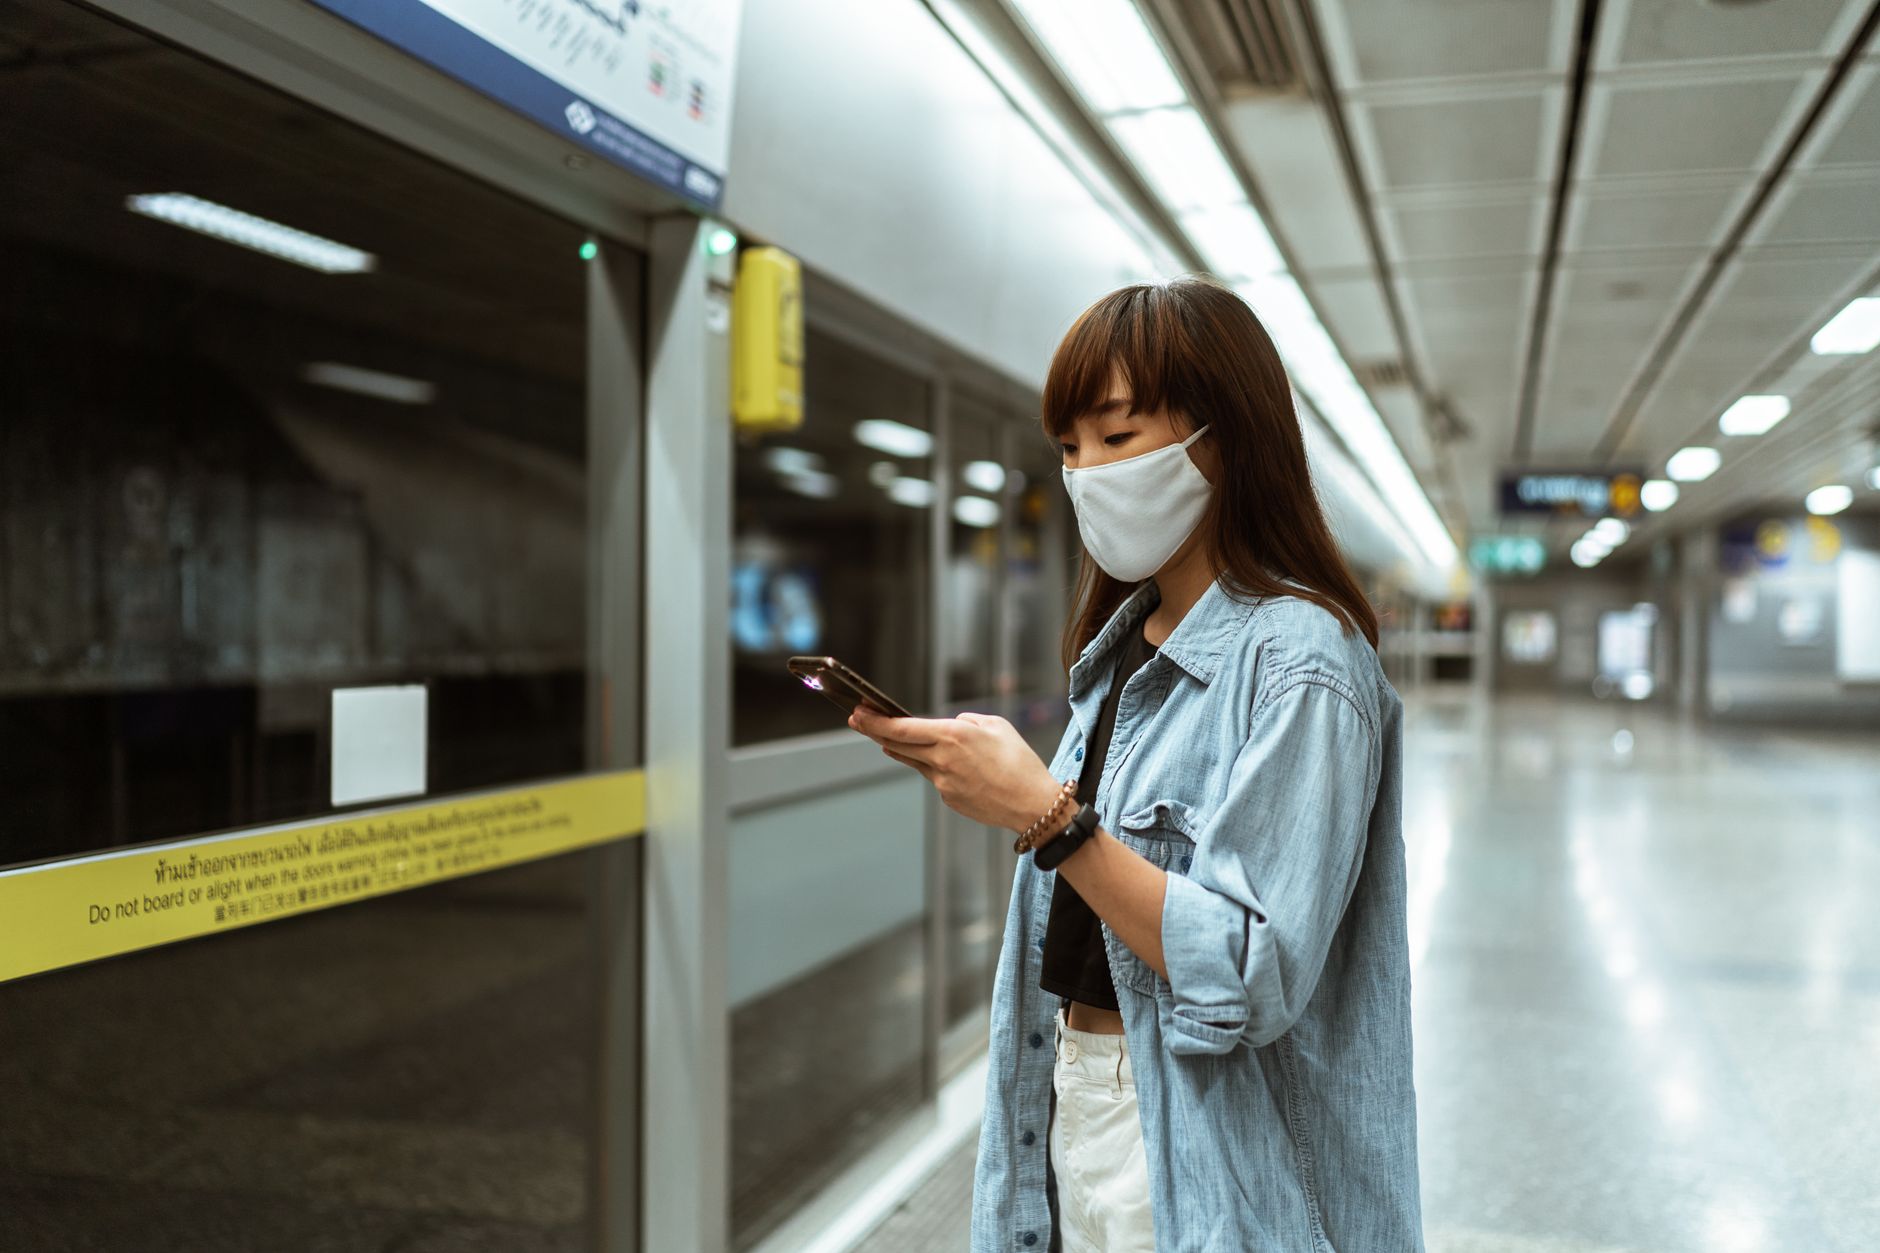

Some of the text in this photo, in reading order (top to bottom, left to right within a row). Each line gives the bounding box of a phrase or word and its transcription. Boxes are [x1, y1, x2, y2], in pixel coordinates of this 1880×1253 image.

[89, 904, 110, 924] Do
[115, 896, 138, 919] not
[143, 887, 185, 913] board
[188, 887, 202, 904] or
[206, 878, 241, 900] alight
[244, 871, 276, 891] when
[280, 867, 298, 886] the
